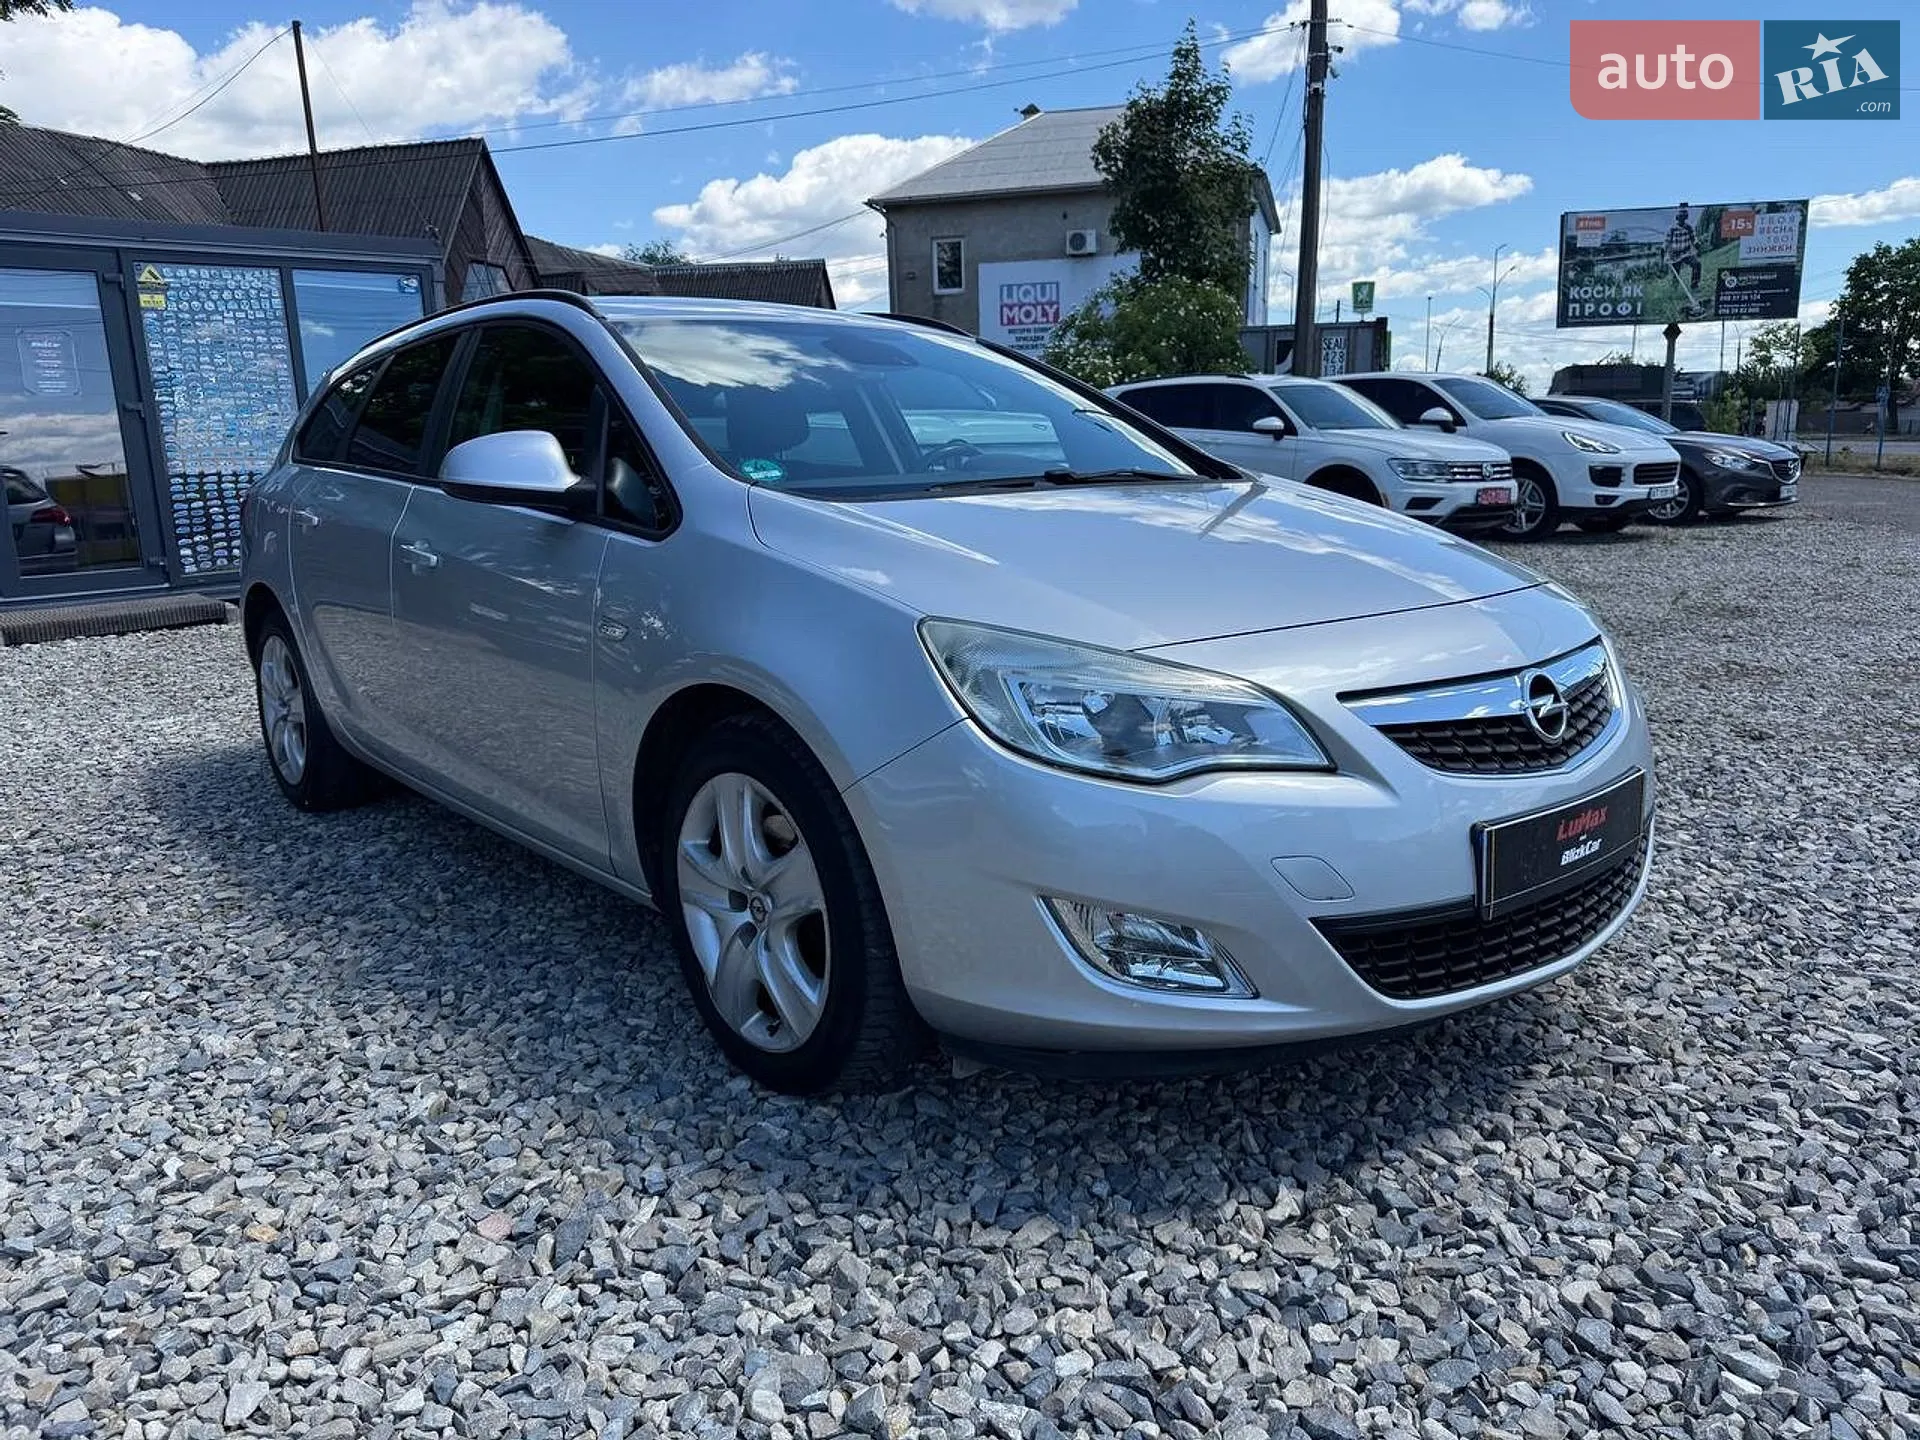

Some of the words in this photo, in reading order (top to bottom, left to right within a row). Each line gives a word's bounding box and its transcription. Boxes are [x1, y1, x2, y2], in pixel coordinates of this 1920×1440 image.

[1002, 284, 1058, 303] LIQUI
[1568, 284, 1618, 299] КОСИ
[1622, 284, 1644, 299] ЯК
[1002, 304, 1059, 325] MOLY
[1567, 301, 1643, 317] ПРОФІ
